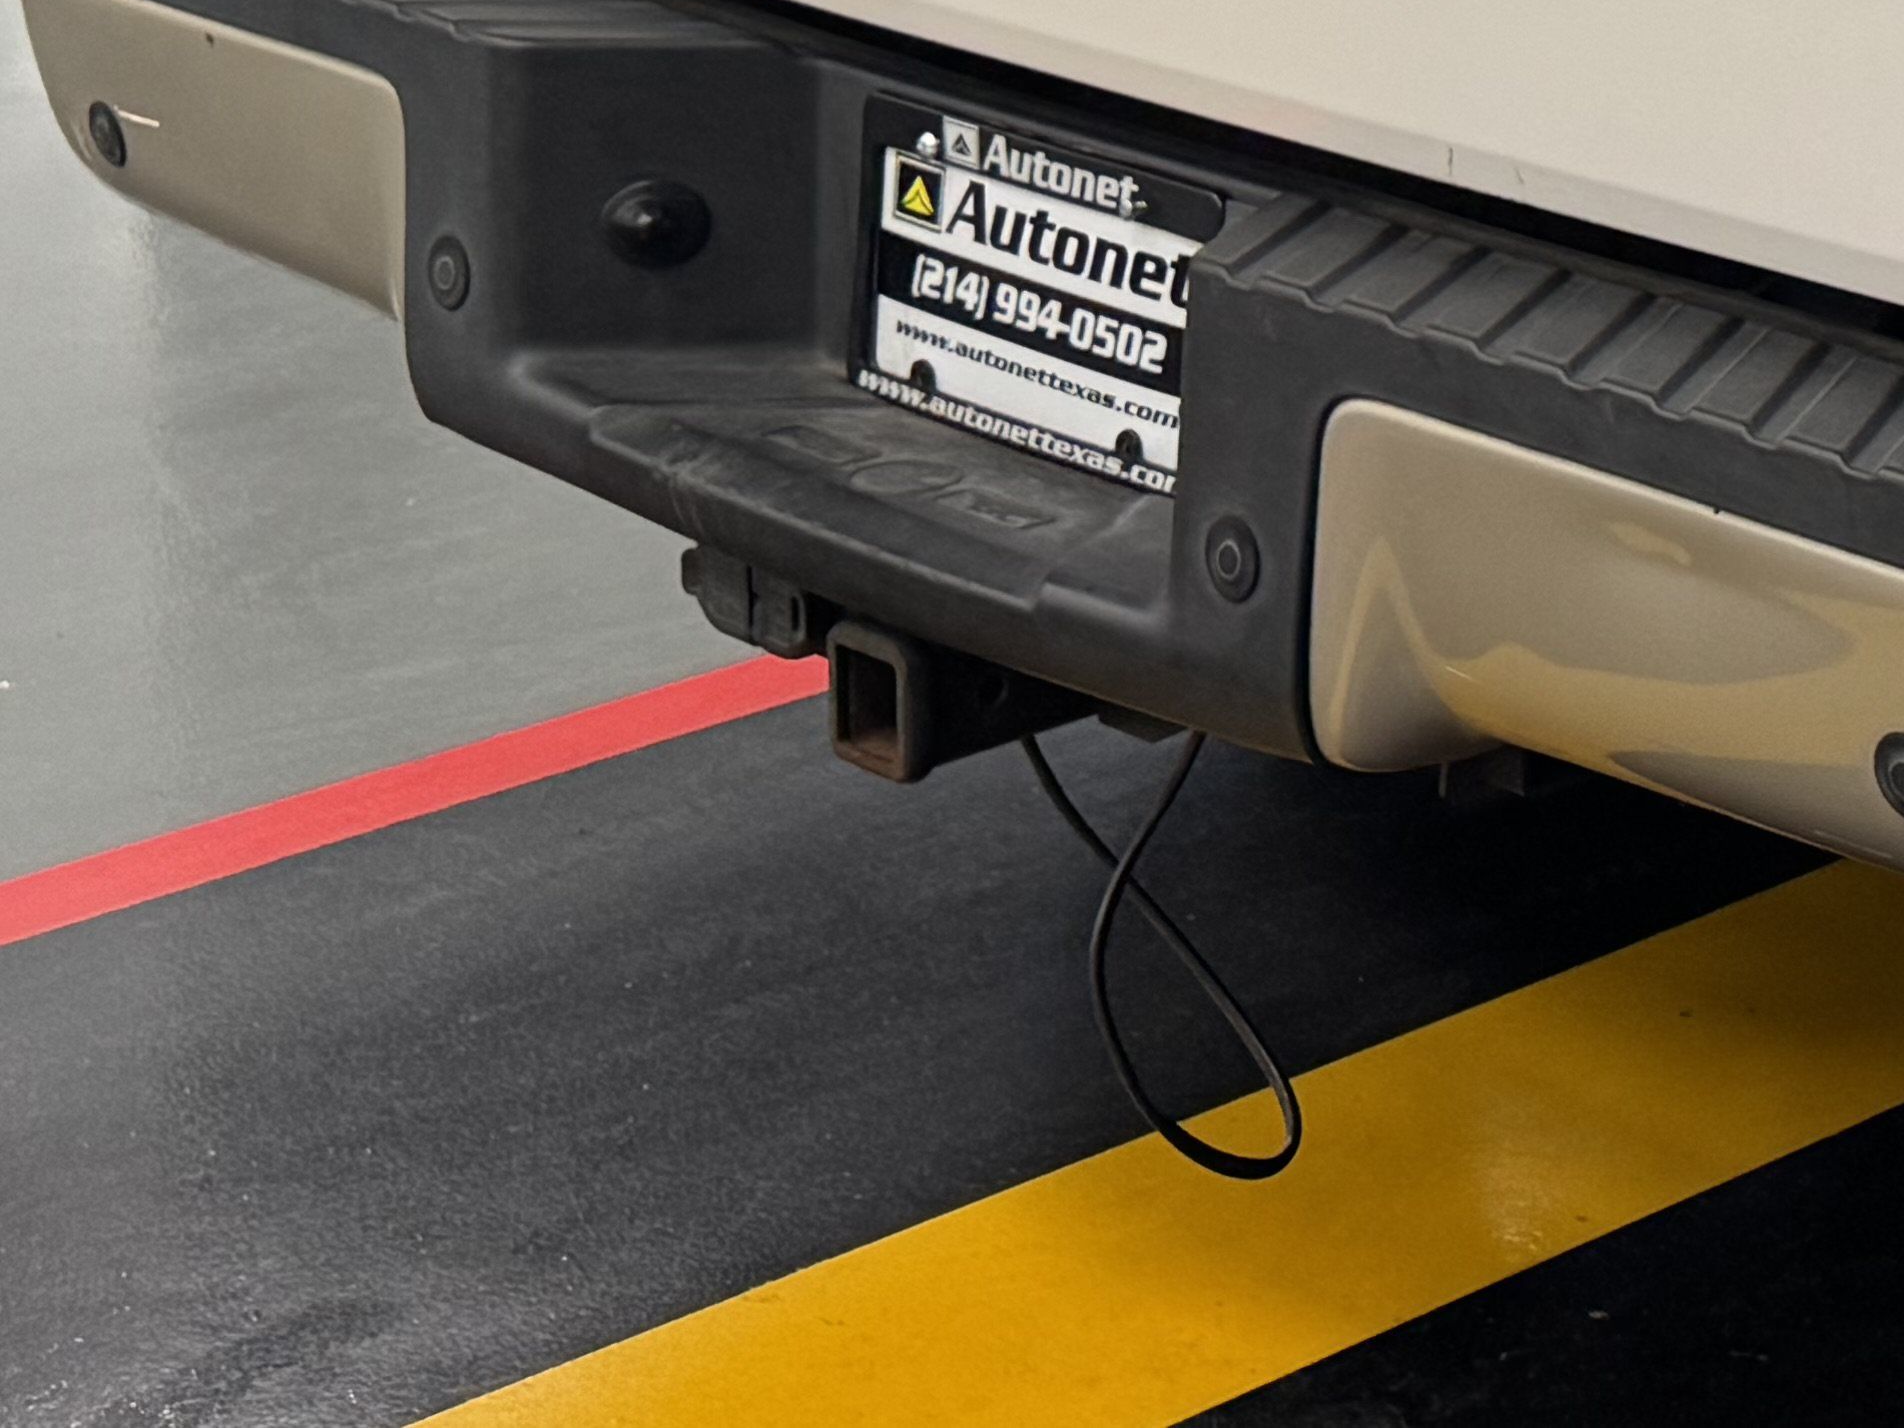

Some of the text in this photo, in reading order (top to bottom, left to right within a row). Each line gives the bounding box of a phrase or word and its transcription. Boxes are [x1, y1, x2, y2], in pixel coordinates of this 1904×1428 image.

[982, 133, 1140, 212] Autonet
[945, 178, 1190, 308] Autonet
[911, 253, 1169, 375] (214) 994-0502
[895, 318, 1180, 431] www.autonettexas.com
